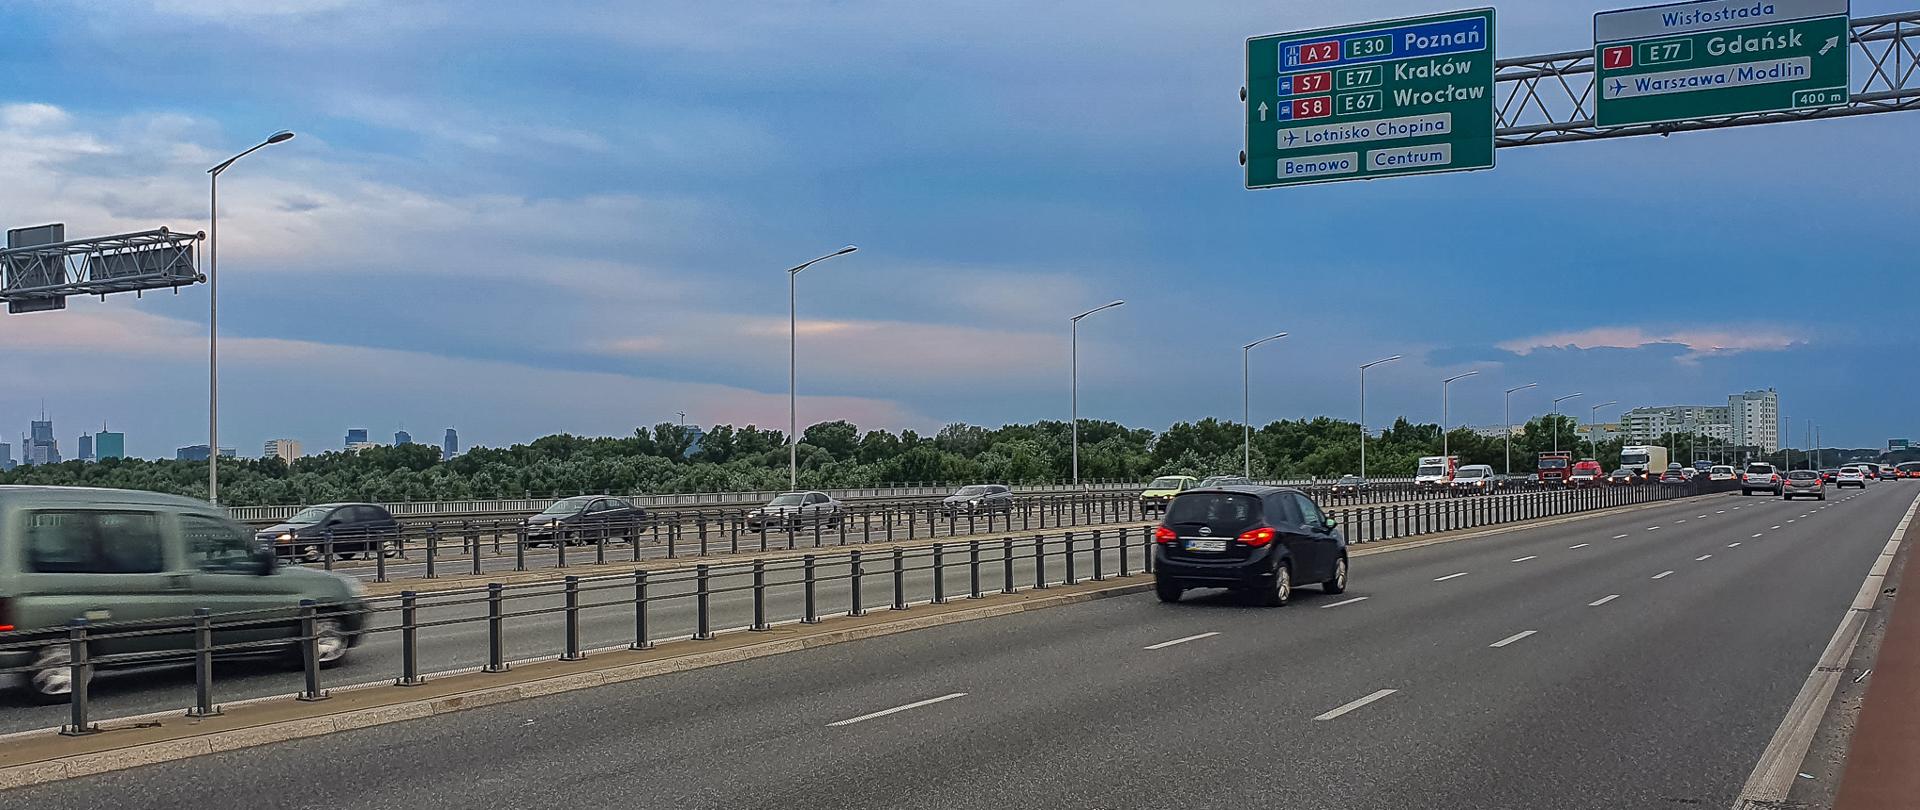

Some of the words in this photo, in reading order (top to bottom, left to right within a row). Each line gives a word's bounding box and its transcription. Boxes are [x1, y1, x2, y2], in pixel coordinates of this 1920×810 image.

[1662, 3, 1774, 27] Wisłostrada
[1405, 26, 1479, 50] Poznań
[1613, 50, 1622, 65] 7
[1707, 29, 1802, 56] Gdańsk
[1395, 58, 1471, 81] Kraków
[1393, 85, 1484, 107] Wrocław
[1800, 93, 1824, 104] 400
[1830, 93, 1841, 101] m
[1305, 125, 1369, 143] Lotnisko
[1376, 119, 1443, 137] Chopina
[1286, 158, 1349, 174] Bemowo
[1375, 151, 1442, 166] Centrum
